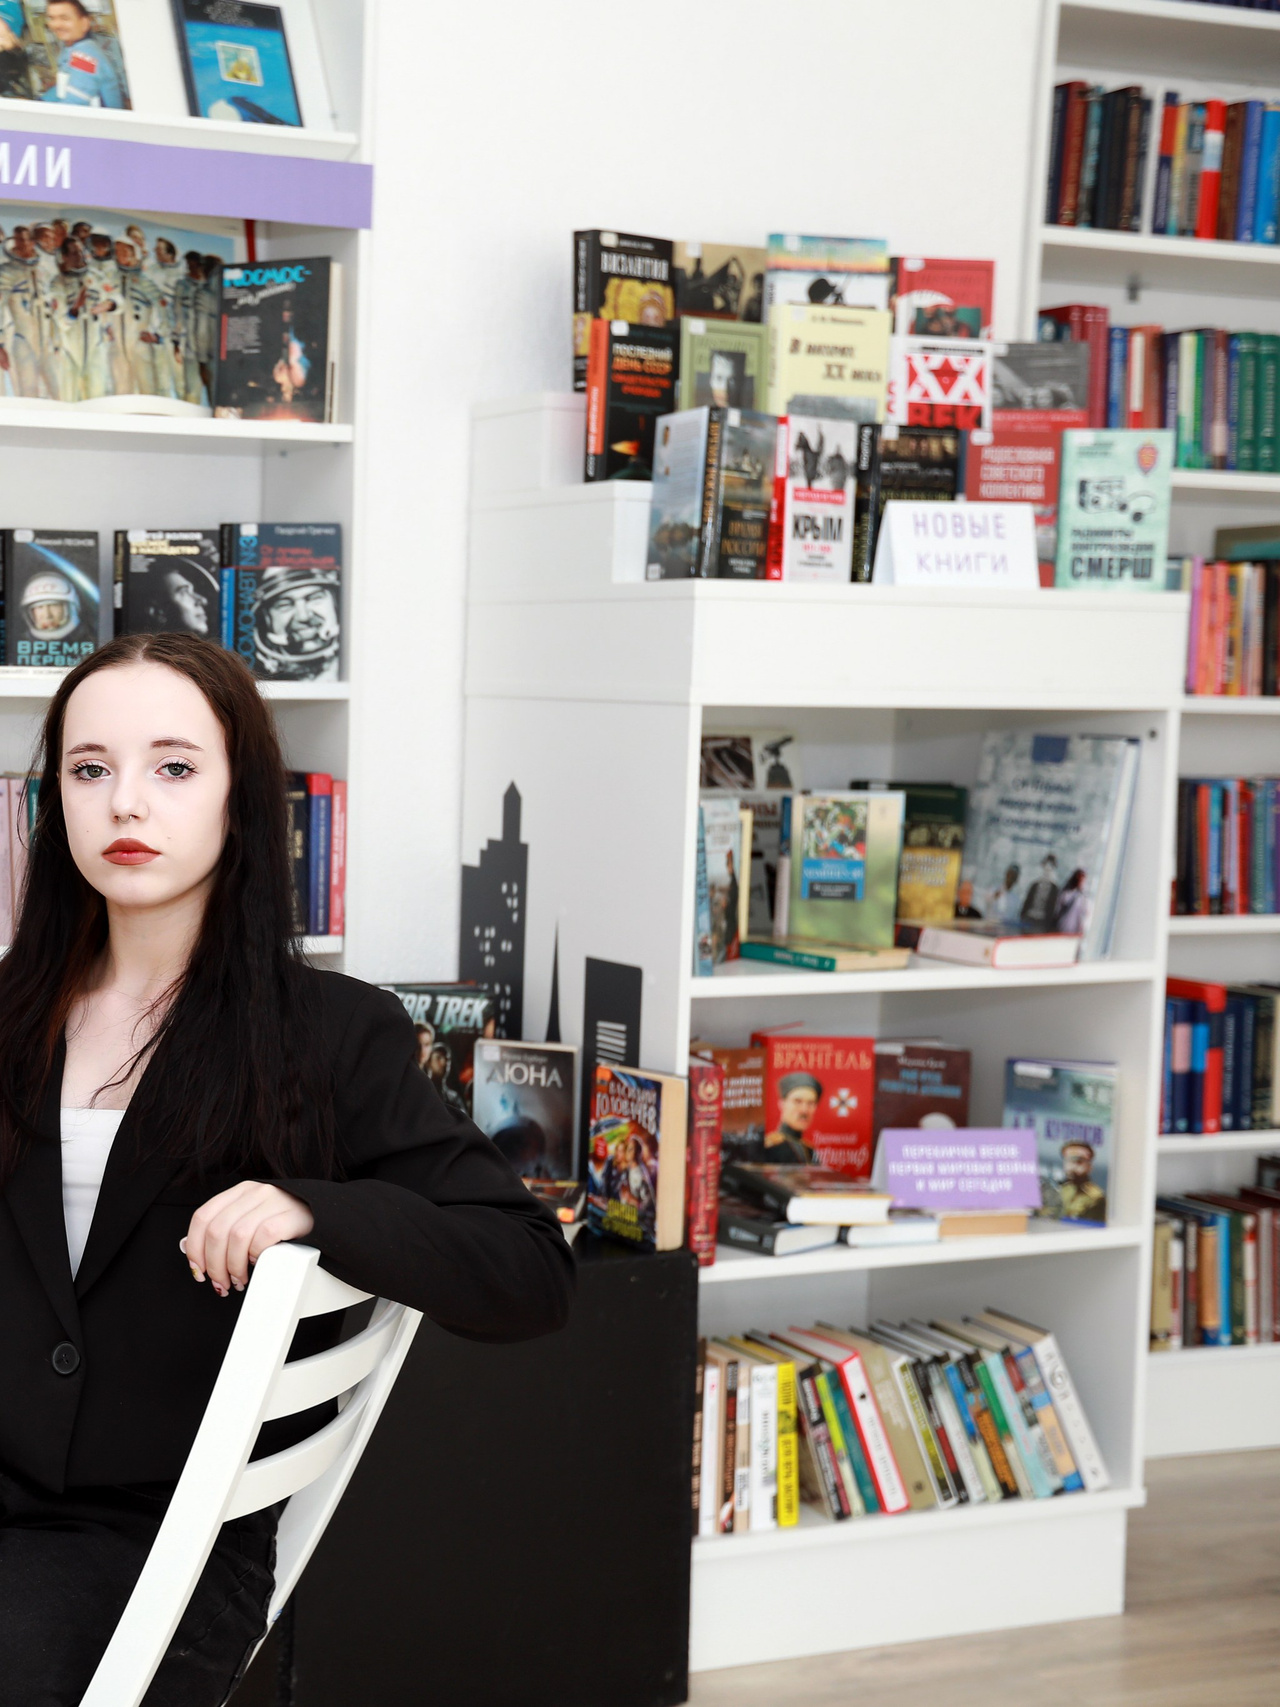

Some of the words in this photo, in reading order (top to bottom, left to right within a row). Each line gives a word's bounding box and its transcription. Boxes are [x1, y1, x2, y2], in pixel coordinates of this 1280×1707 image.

[792, 513, 844, 543] КРЫМ
[913, 512, 1007, 541] НОВЫЕ
[916, 553, 1009, 576] КНИГИ
[1071, 556, 1154, 580] СМЕРШ
[237, 570, 257, 670] ОСМОНАВТ
[16, 640, 95, 656] ВРЕМЯ
[16, 655, 82, 667] ПЕРВЫ
[434, 994, 490, 1029] TREK
[773, 1051, 872, 1070] ВРАНГЕЛЬ
